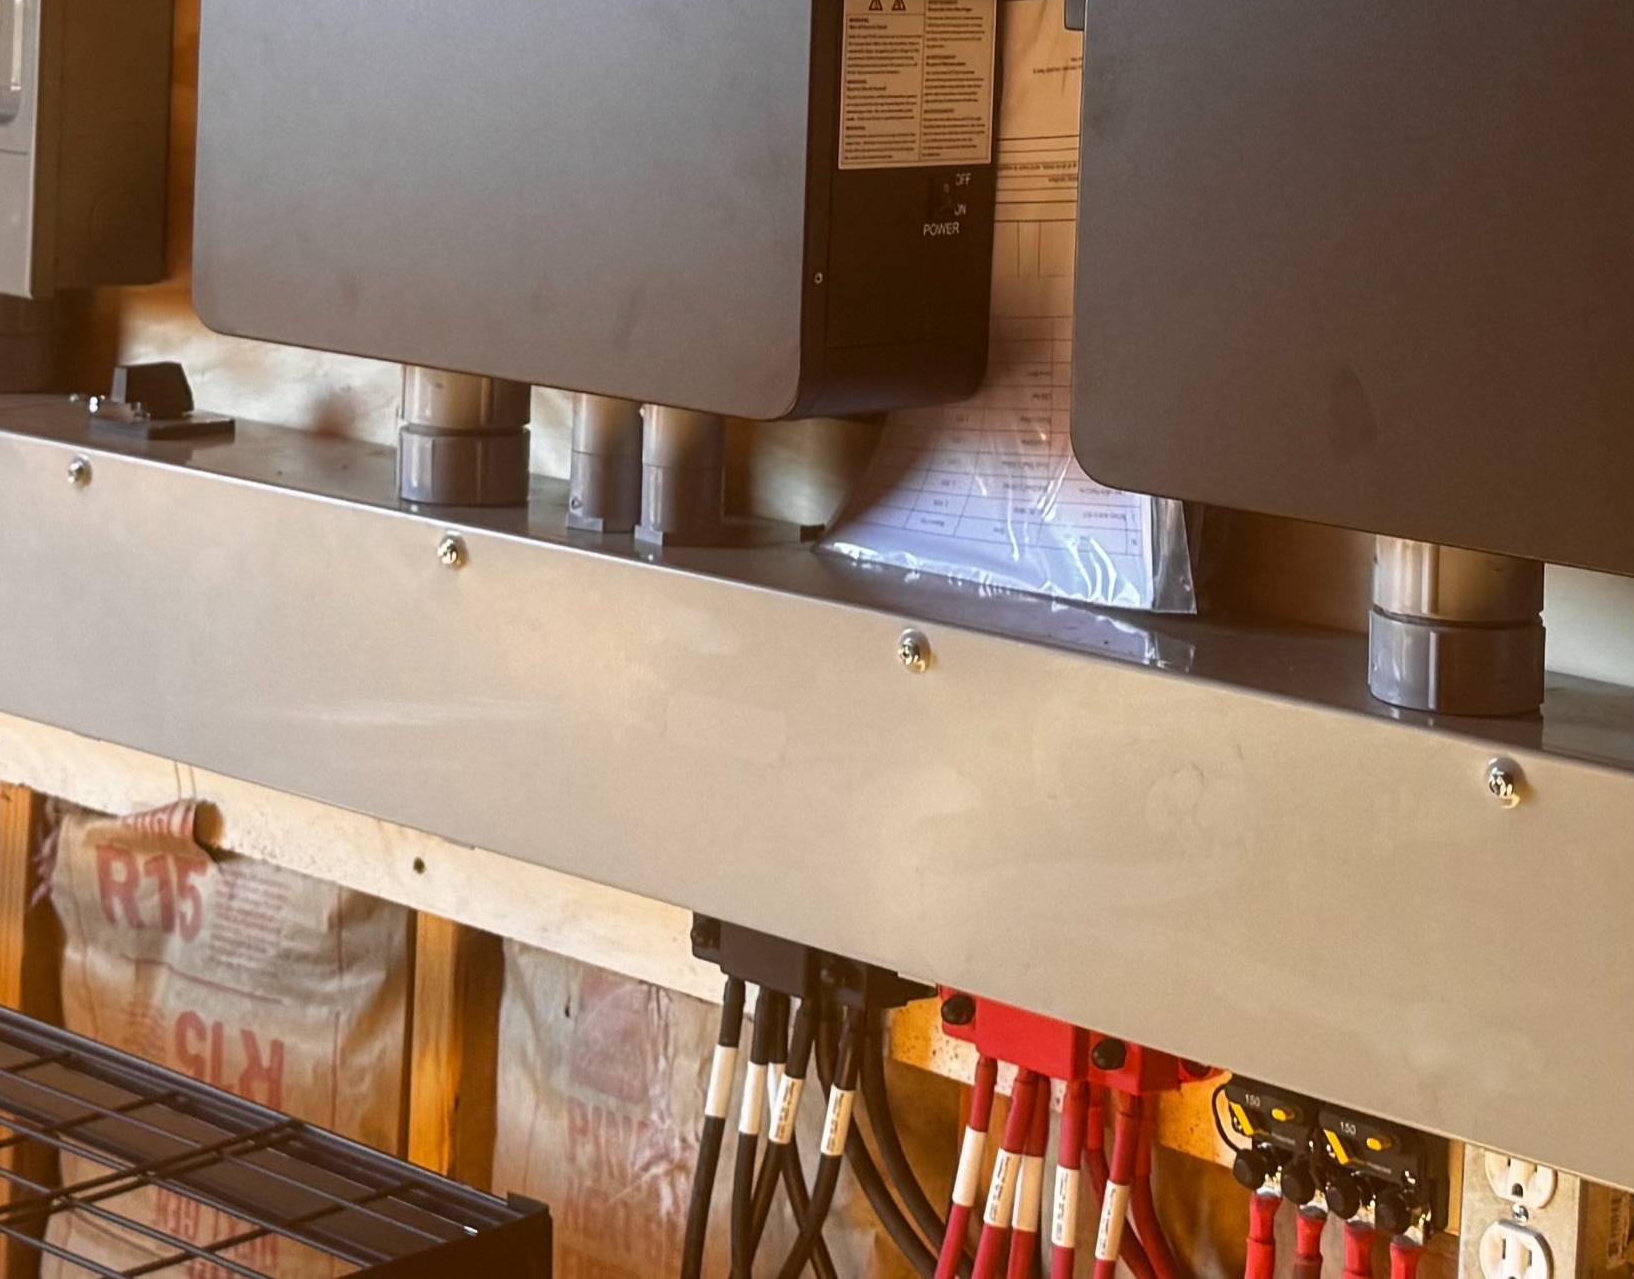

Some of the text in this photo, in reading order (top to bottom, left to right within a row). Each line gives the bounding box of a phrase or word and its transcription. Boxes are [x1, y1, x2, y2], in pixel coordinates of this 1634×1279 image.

[922, 221, 960, 237] POWER
[95, 844, 211, 944] R15
[1244, 1093, 1261, 1108] 150
[1339, 1121, 1357, 1135] 150
